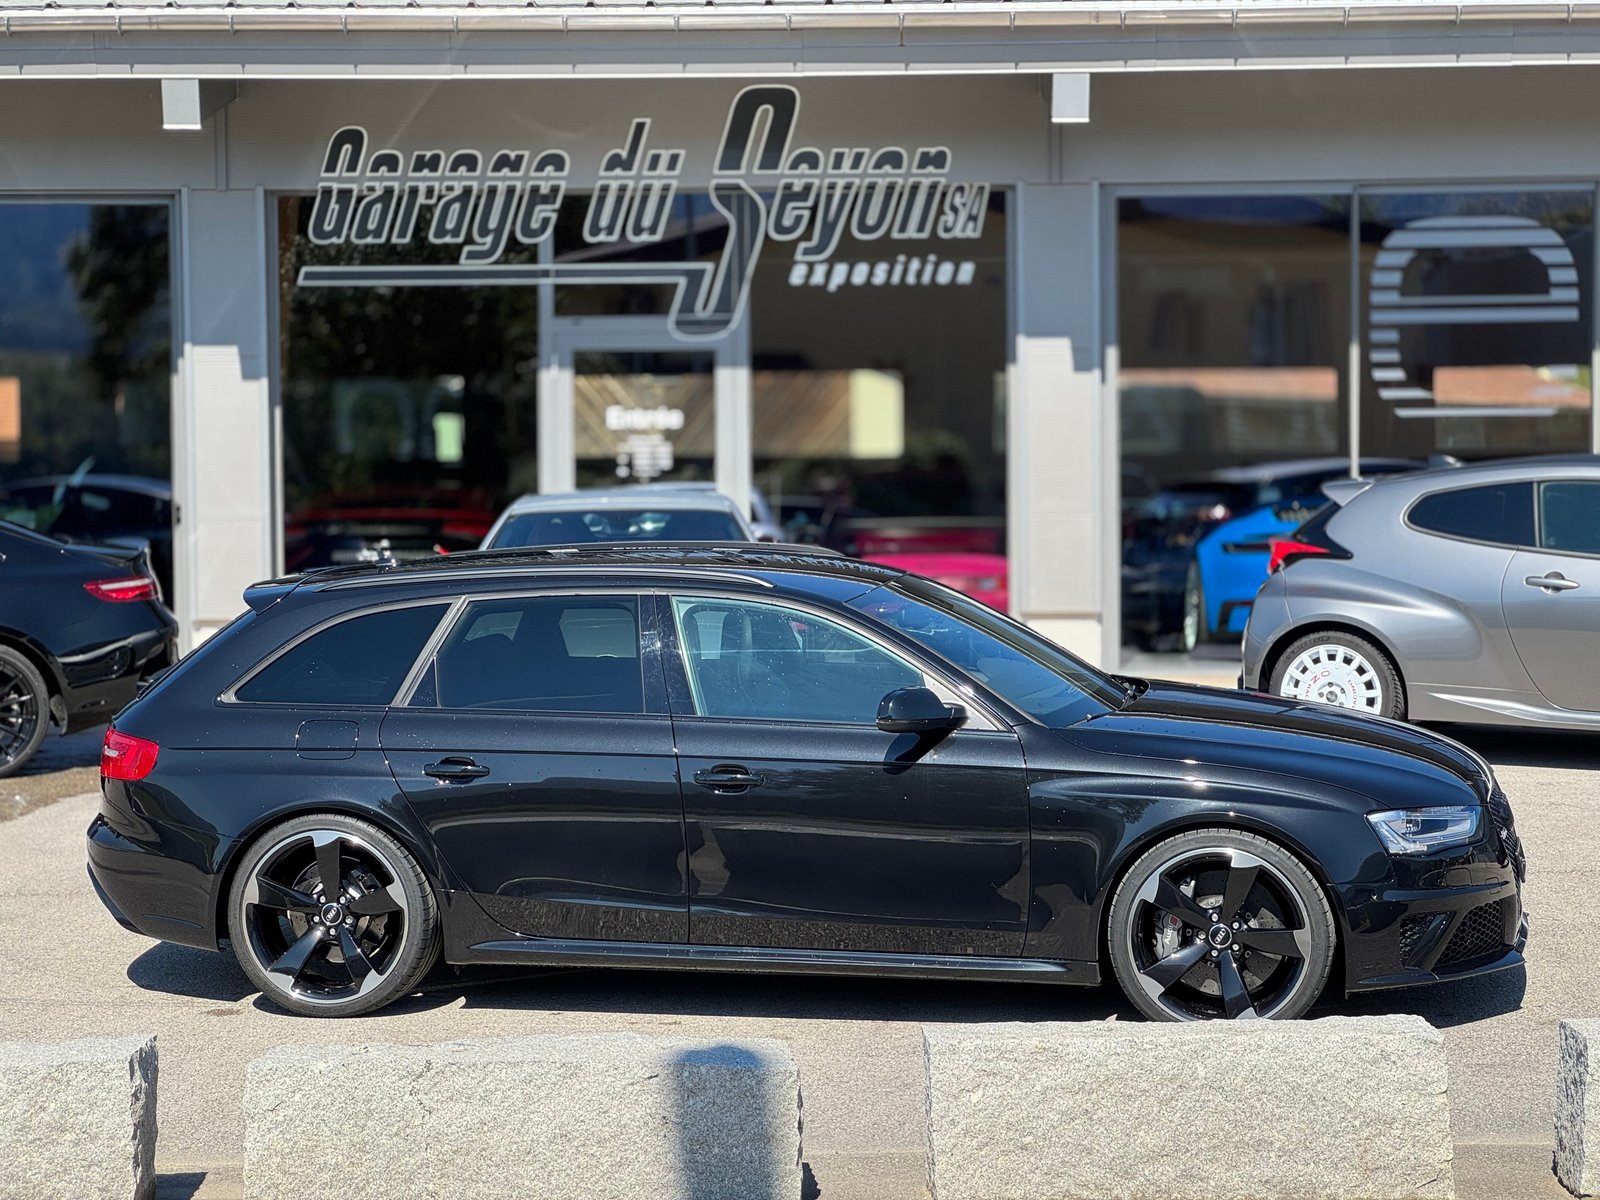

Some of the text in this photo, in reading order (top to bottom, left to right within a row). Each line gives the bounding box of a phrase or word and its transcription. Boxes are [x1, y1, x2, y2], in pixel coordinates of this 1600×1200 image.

[308, 84, 990, 341] Garage du Seyon SA
[788, 255, 976, 292] exposition
[1165, 925, 1173, 945] Audi
